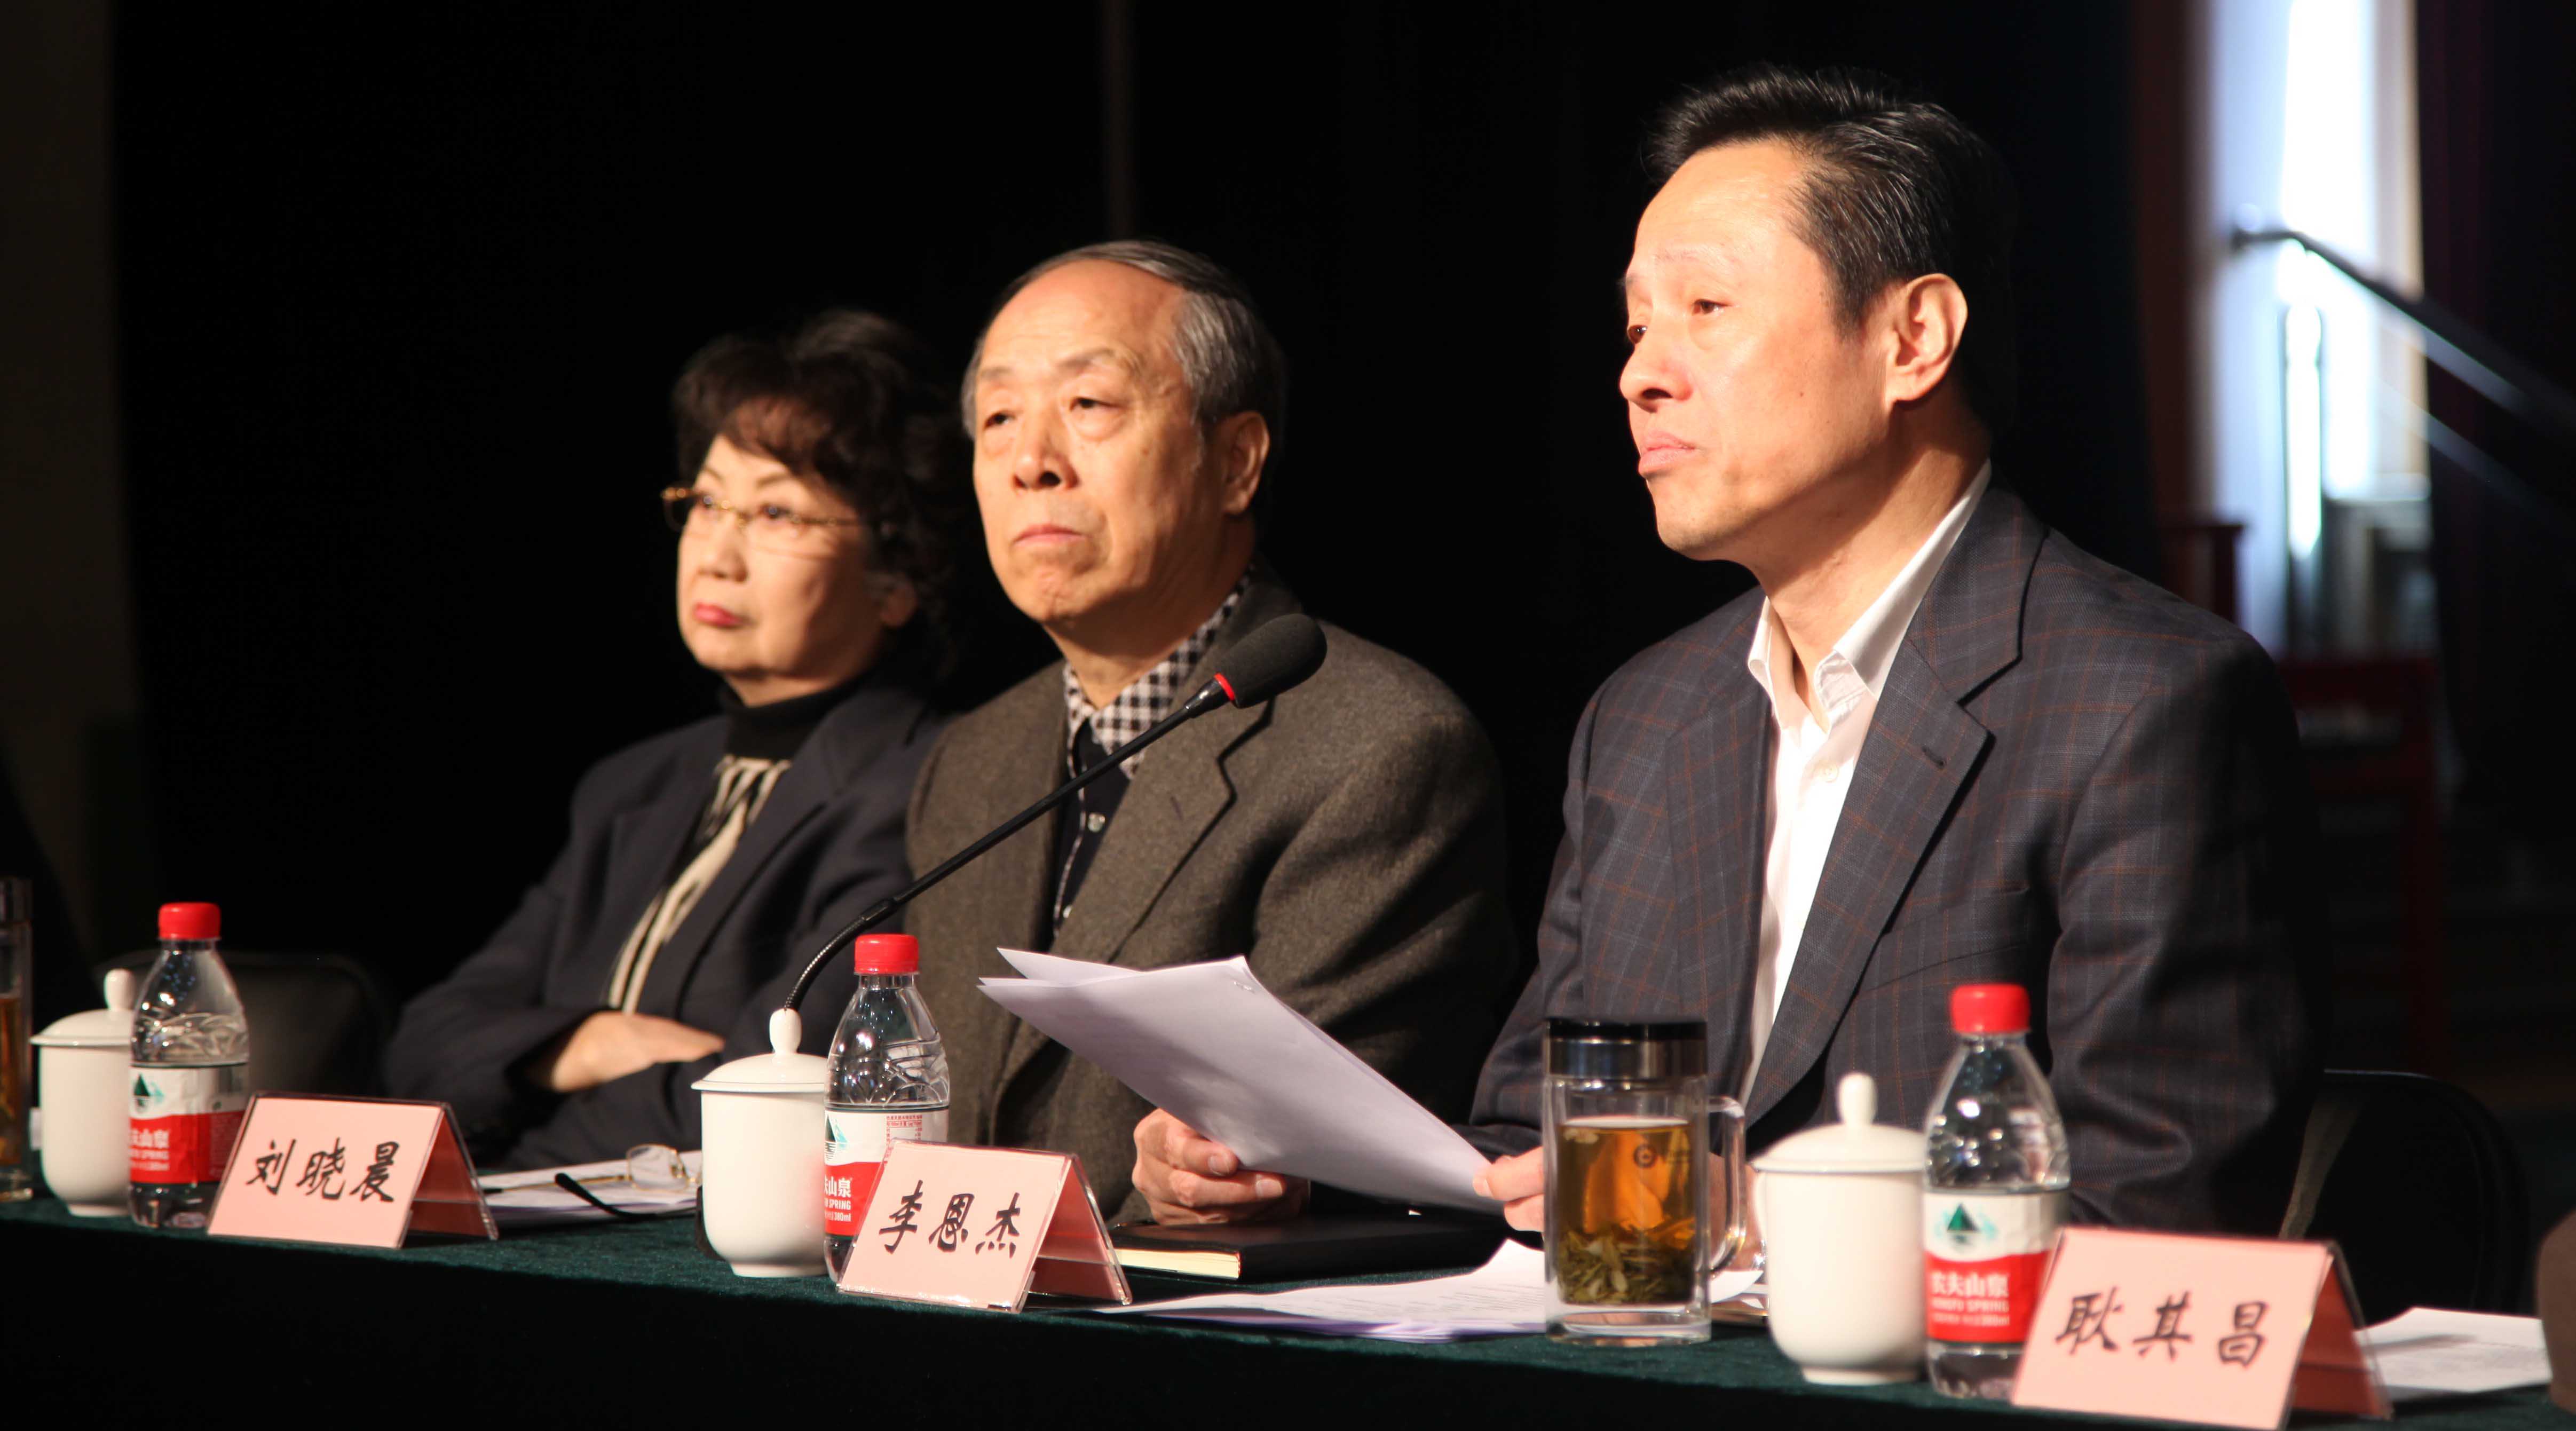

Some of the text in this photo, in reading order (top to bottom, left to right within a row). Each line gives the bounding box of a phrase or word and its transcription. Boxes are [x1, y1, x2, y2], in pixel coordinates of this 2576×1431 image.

[246, 1137, 400, 1202] 刘晓晨
[829, 1198, 851, 1211] SPRING
[879, 1179, 1021, 1259] 李恩杰
[2055, 1286, 2269, 1367] 耿其昌
